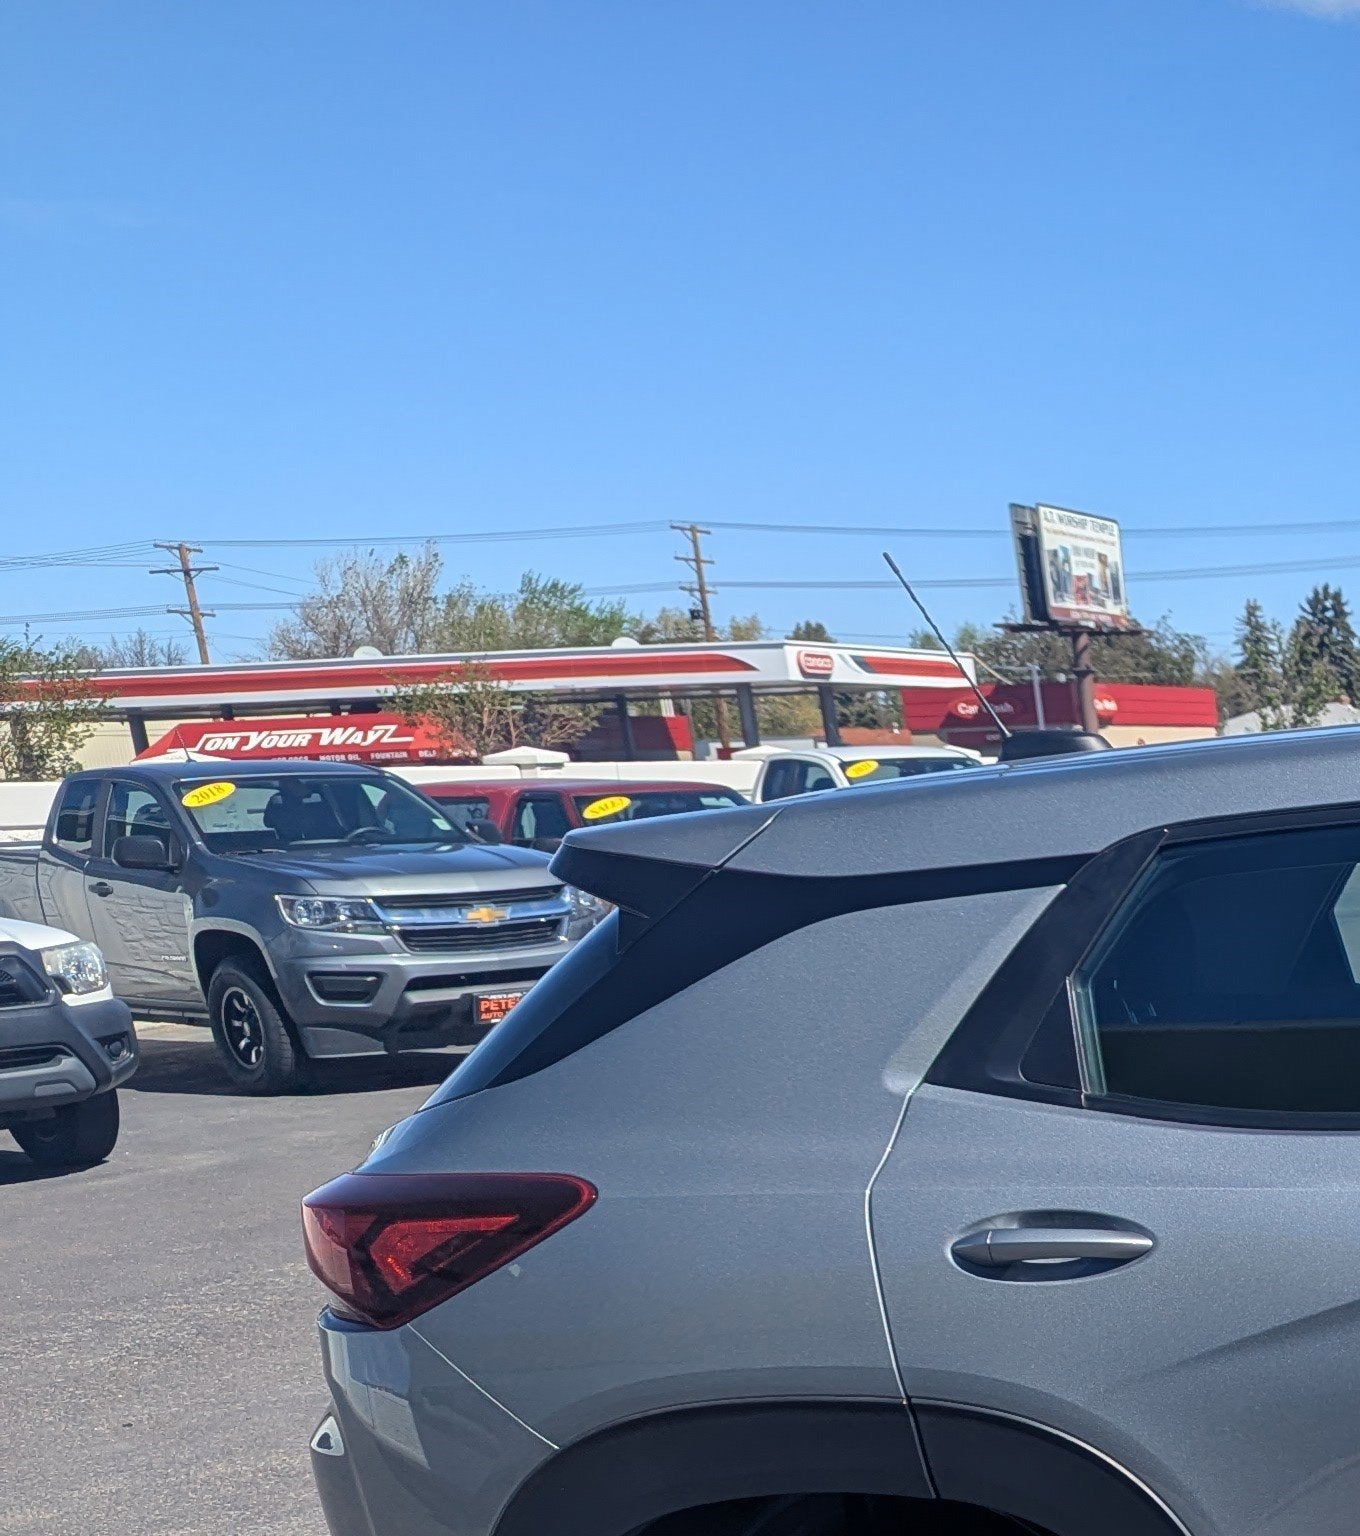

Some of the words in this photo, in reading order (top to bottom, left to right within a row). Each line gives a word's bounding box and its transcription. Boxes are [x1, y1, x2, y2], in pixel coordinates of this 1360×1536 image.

[203, 736, 238, 751] ON
[241, 731, 314, 752] YOUR
[319, 727, 392, 748] WAY
[319, 753, 347, 762] MOTOR
[370, 751, 409, 761] FOUNTAIN
[190, 783, 228, 805] 2018
